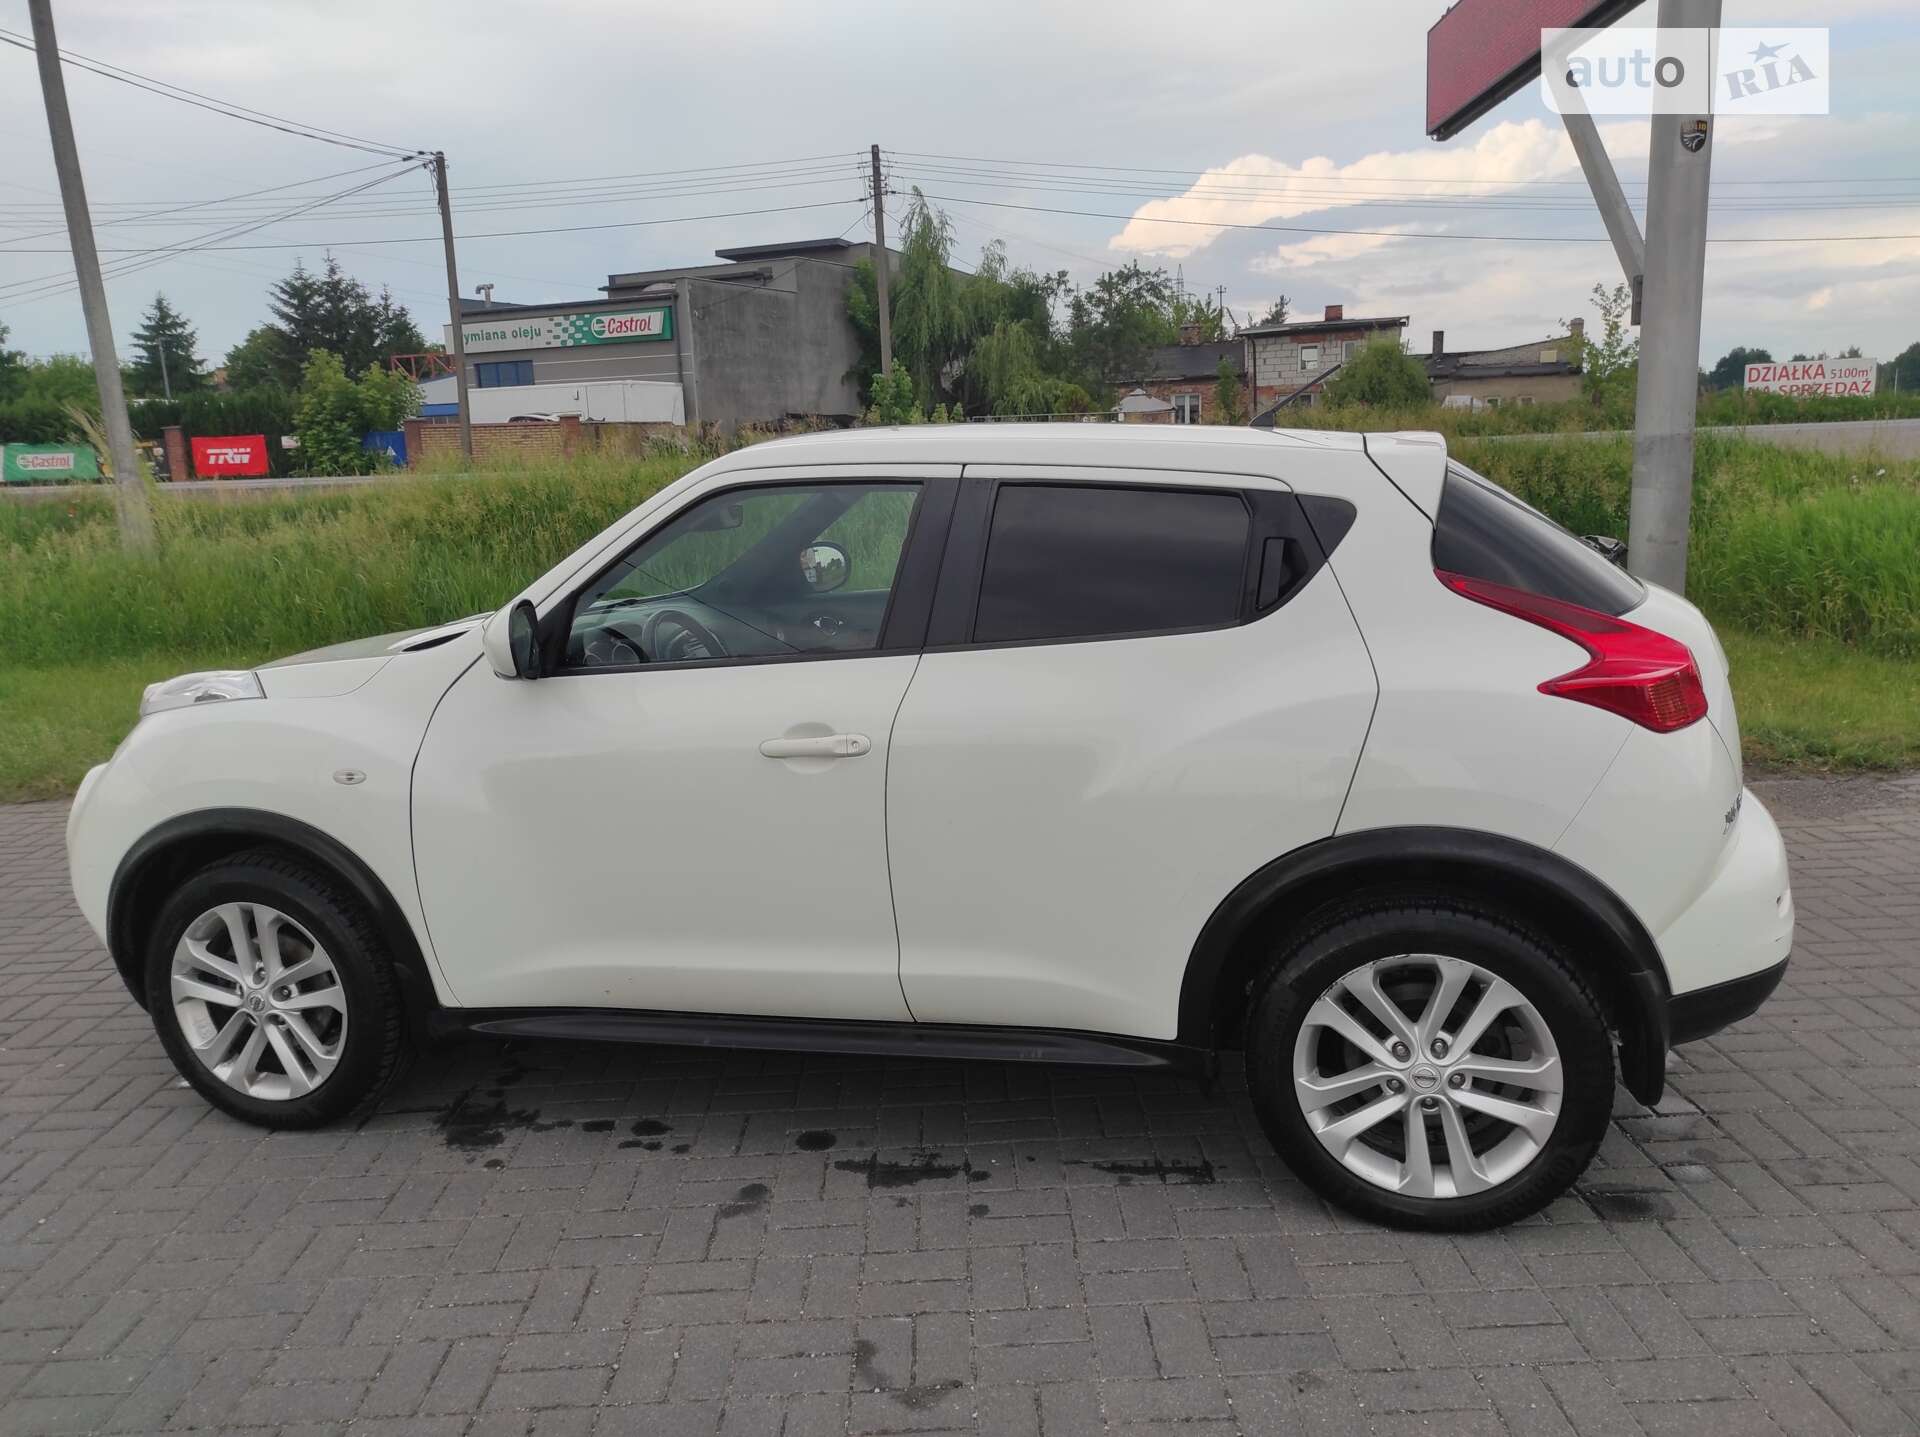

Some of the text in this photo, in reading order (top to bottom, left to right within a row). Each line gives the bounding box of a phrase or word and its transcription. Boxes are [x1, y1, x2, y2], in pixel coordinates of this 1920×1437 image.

[608, 316, 652, 334] Castrol
[464, 325, 541, 345] ymiana oleju
[1748, 364, 1826, 383] DZIAŁKA
[31, 455, 70, 468] Castrol
[206, 447, 251, 465] TRW
